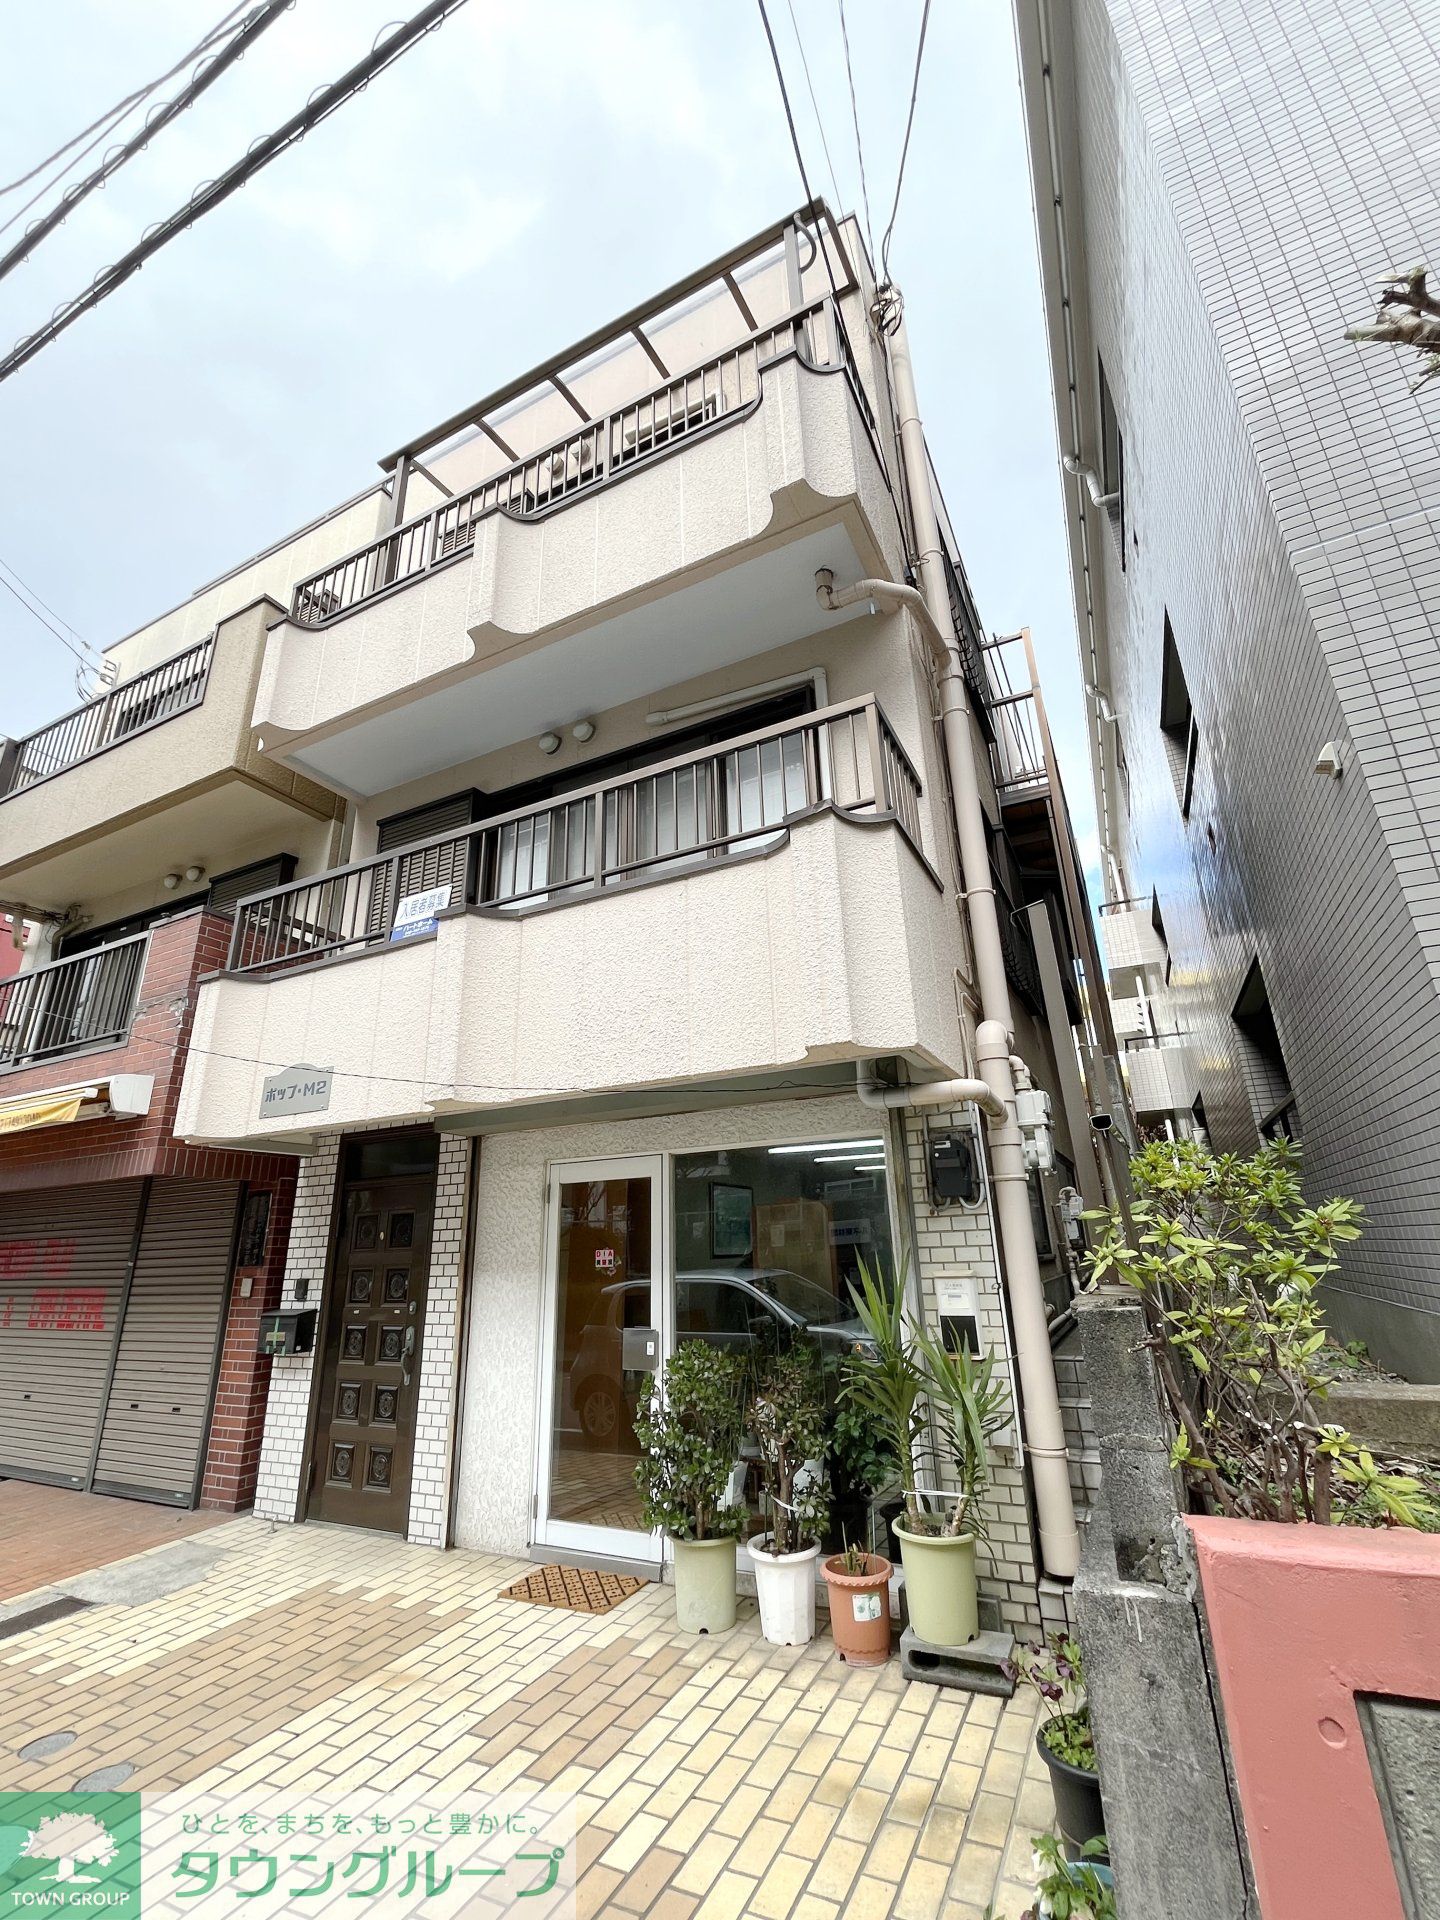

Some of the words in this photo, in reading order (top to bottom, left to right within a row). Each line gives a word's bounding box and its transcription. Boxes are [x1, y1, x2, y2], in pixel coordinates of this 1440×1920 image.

[399, 891, 446, 920] 入居者募集
